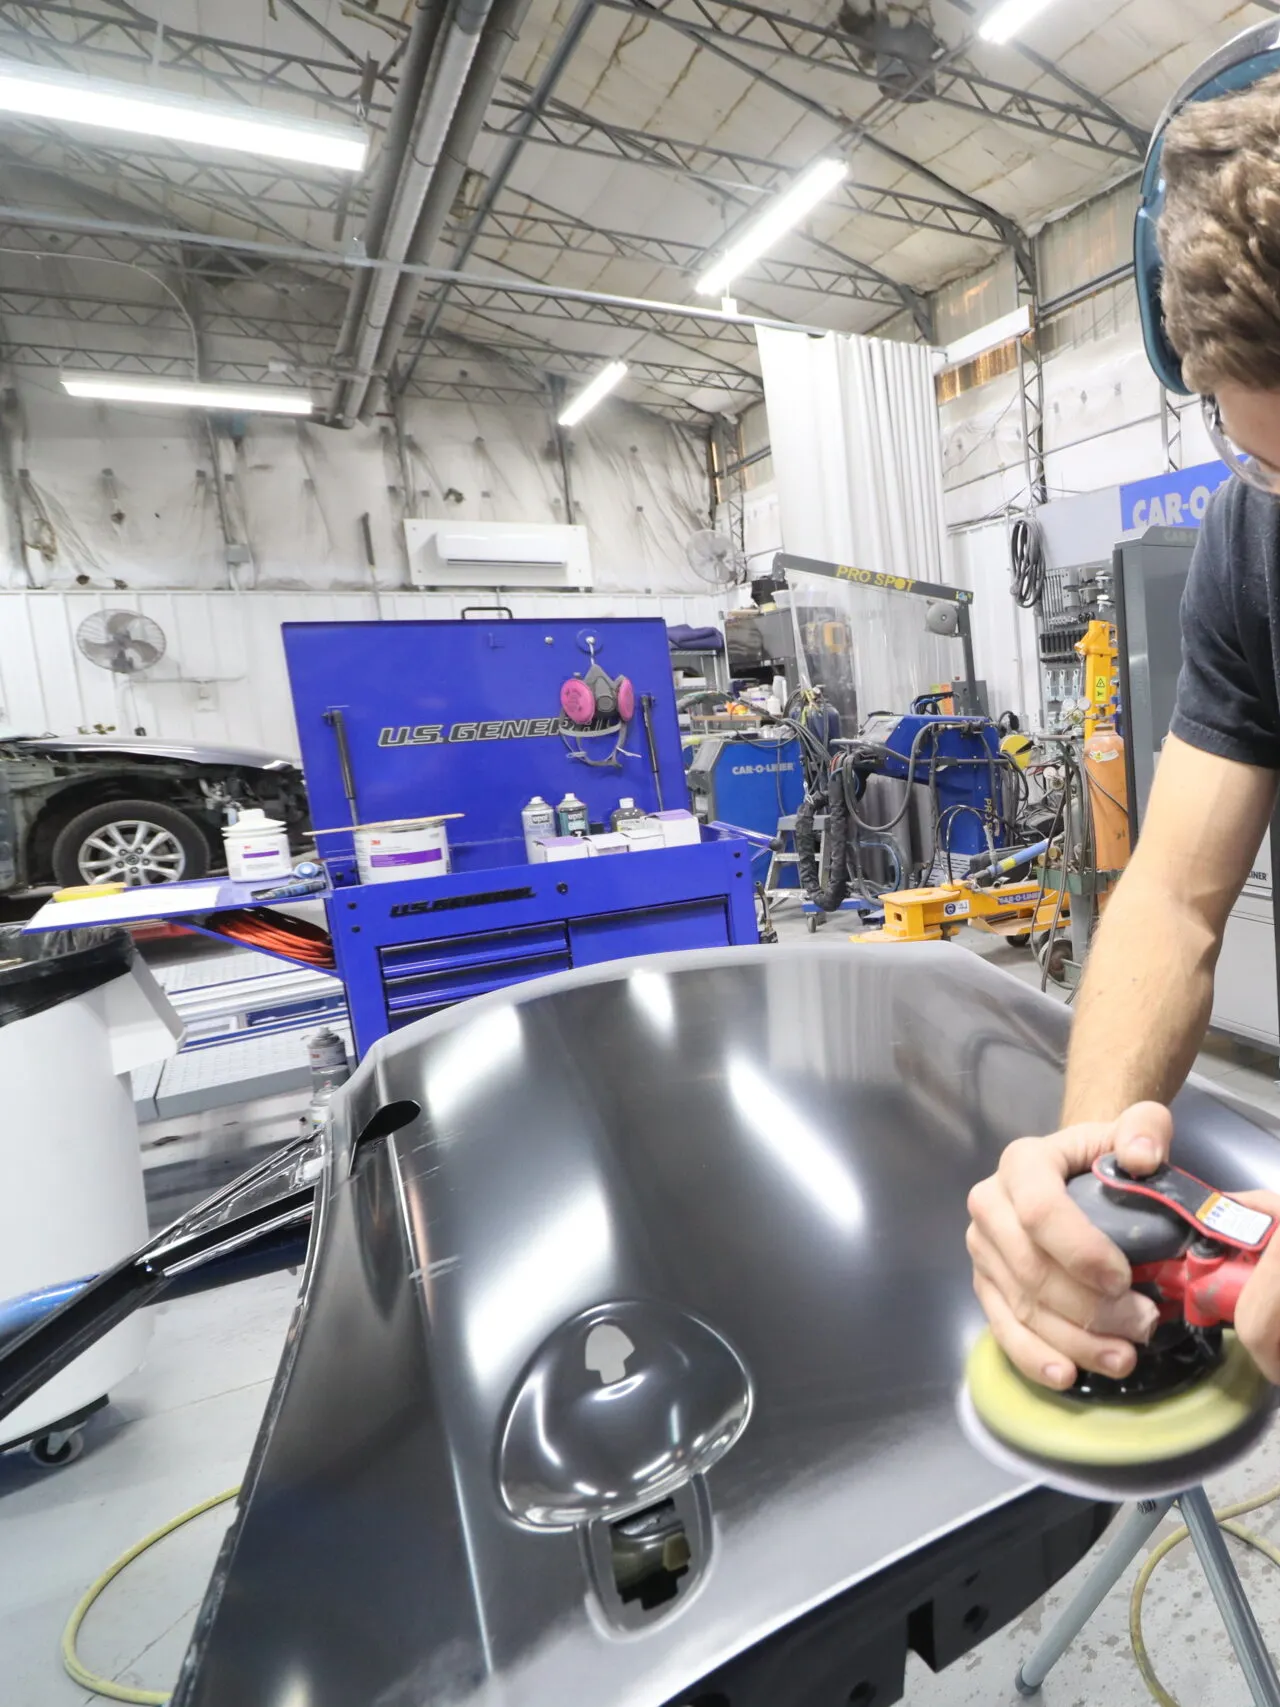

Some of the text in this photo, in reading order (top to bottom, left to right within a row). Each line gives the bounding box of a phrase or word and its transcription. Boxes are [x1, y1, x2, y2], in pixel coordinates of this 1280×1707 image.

[836, 564, 917, 593] PRO SPOT
[1249, 870, 1267, 881] INER
